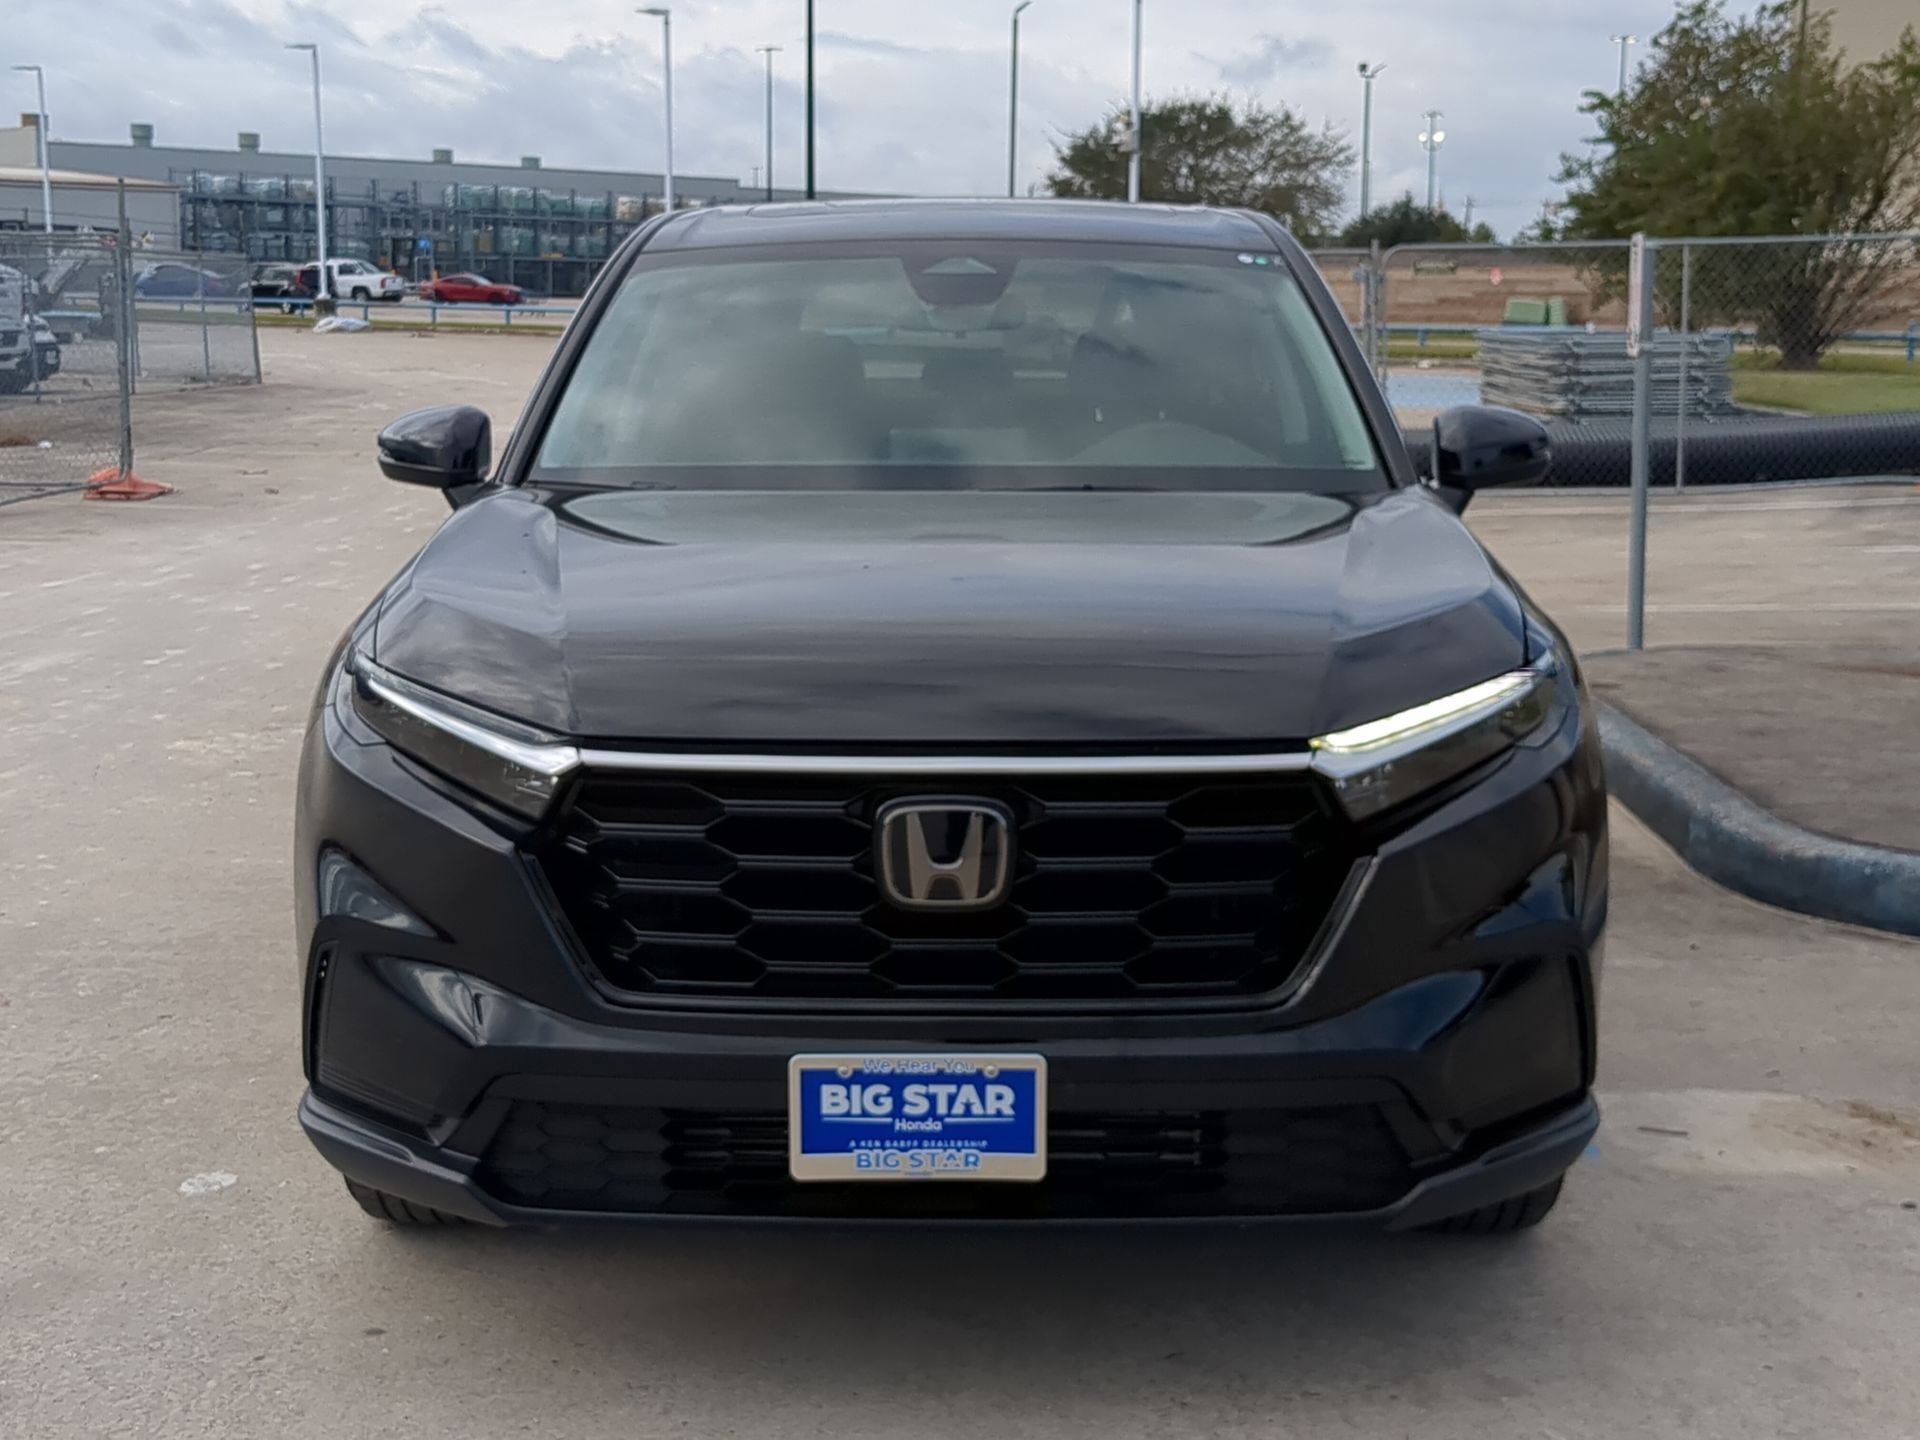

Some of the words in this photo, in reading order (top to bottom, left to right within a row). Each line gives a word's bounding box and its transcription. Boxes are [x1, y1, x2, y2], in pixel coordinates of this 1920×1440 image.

[863, 1058, 891, 1074] We
[895, 1058, 938, 1074] Hear
[943, 1058, 978, 1074] You
[820, 1083, 894, 1116] BIG
[902, 1083, 1016, 1116] STAR
[894, 1118, 943, 1132] Honda
[855, 1150, 902, 1169] BIG
[907, 1150, 982, 1169] STAR
